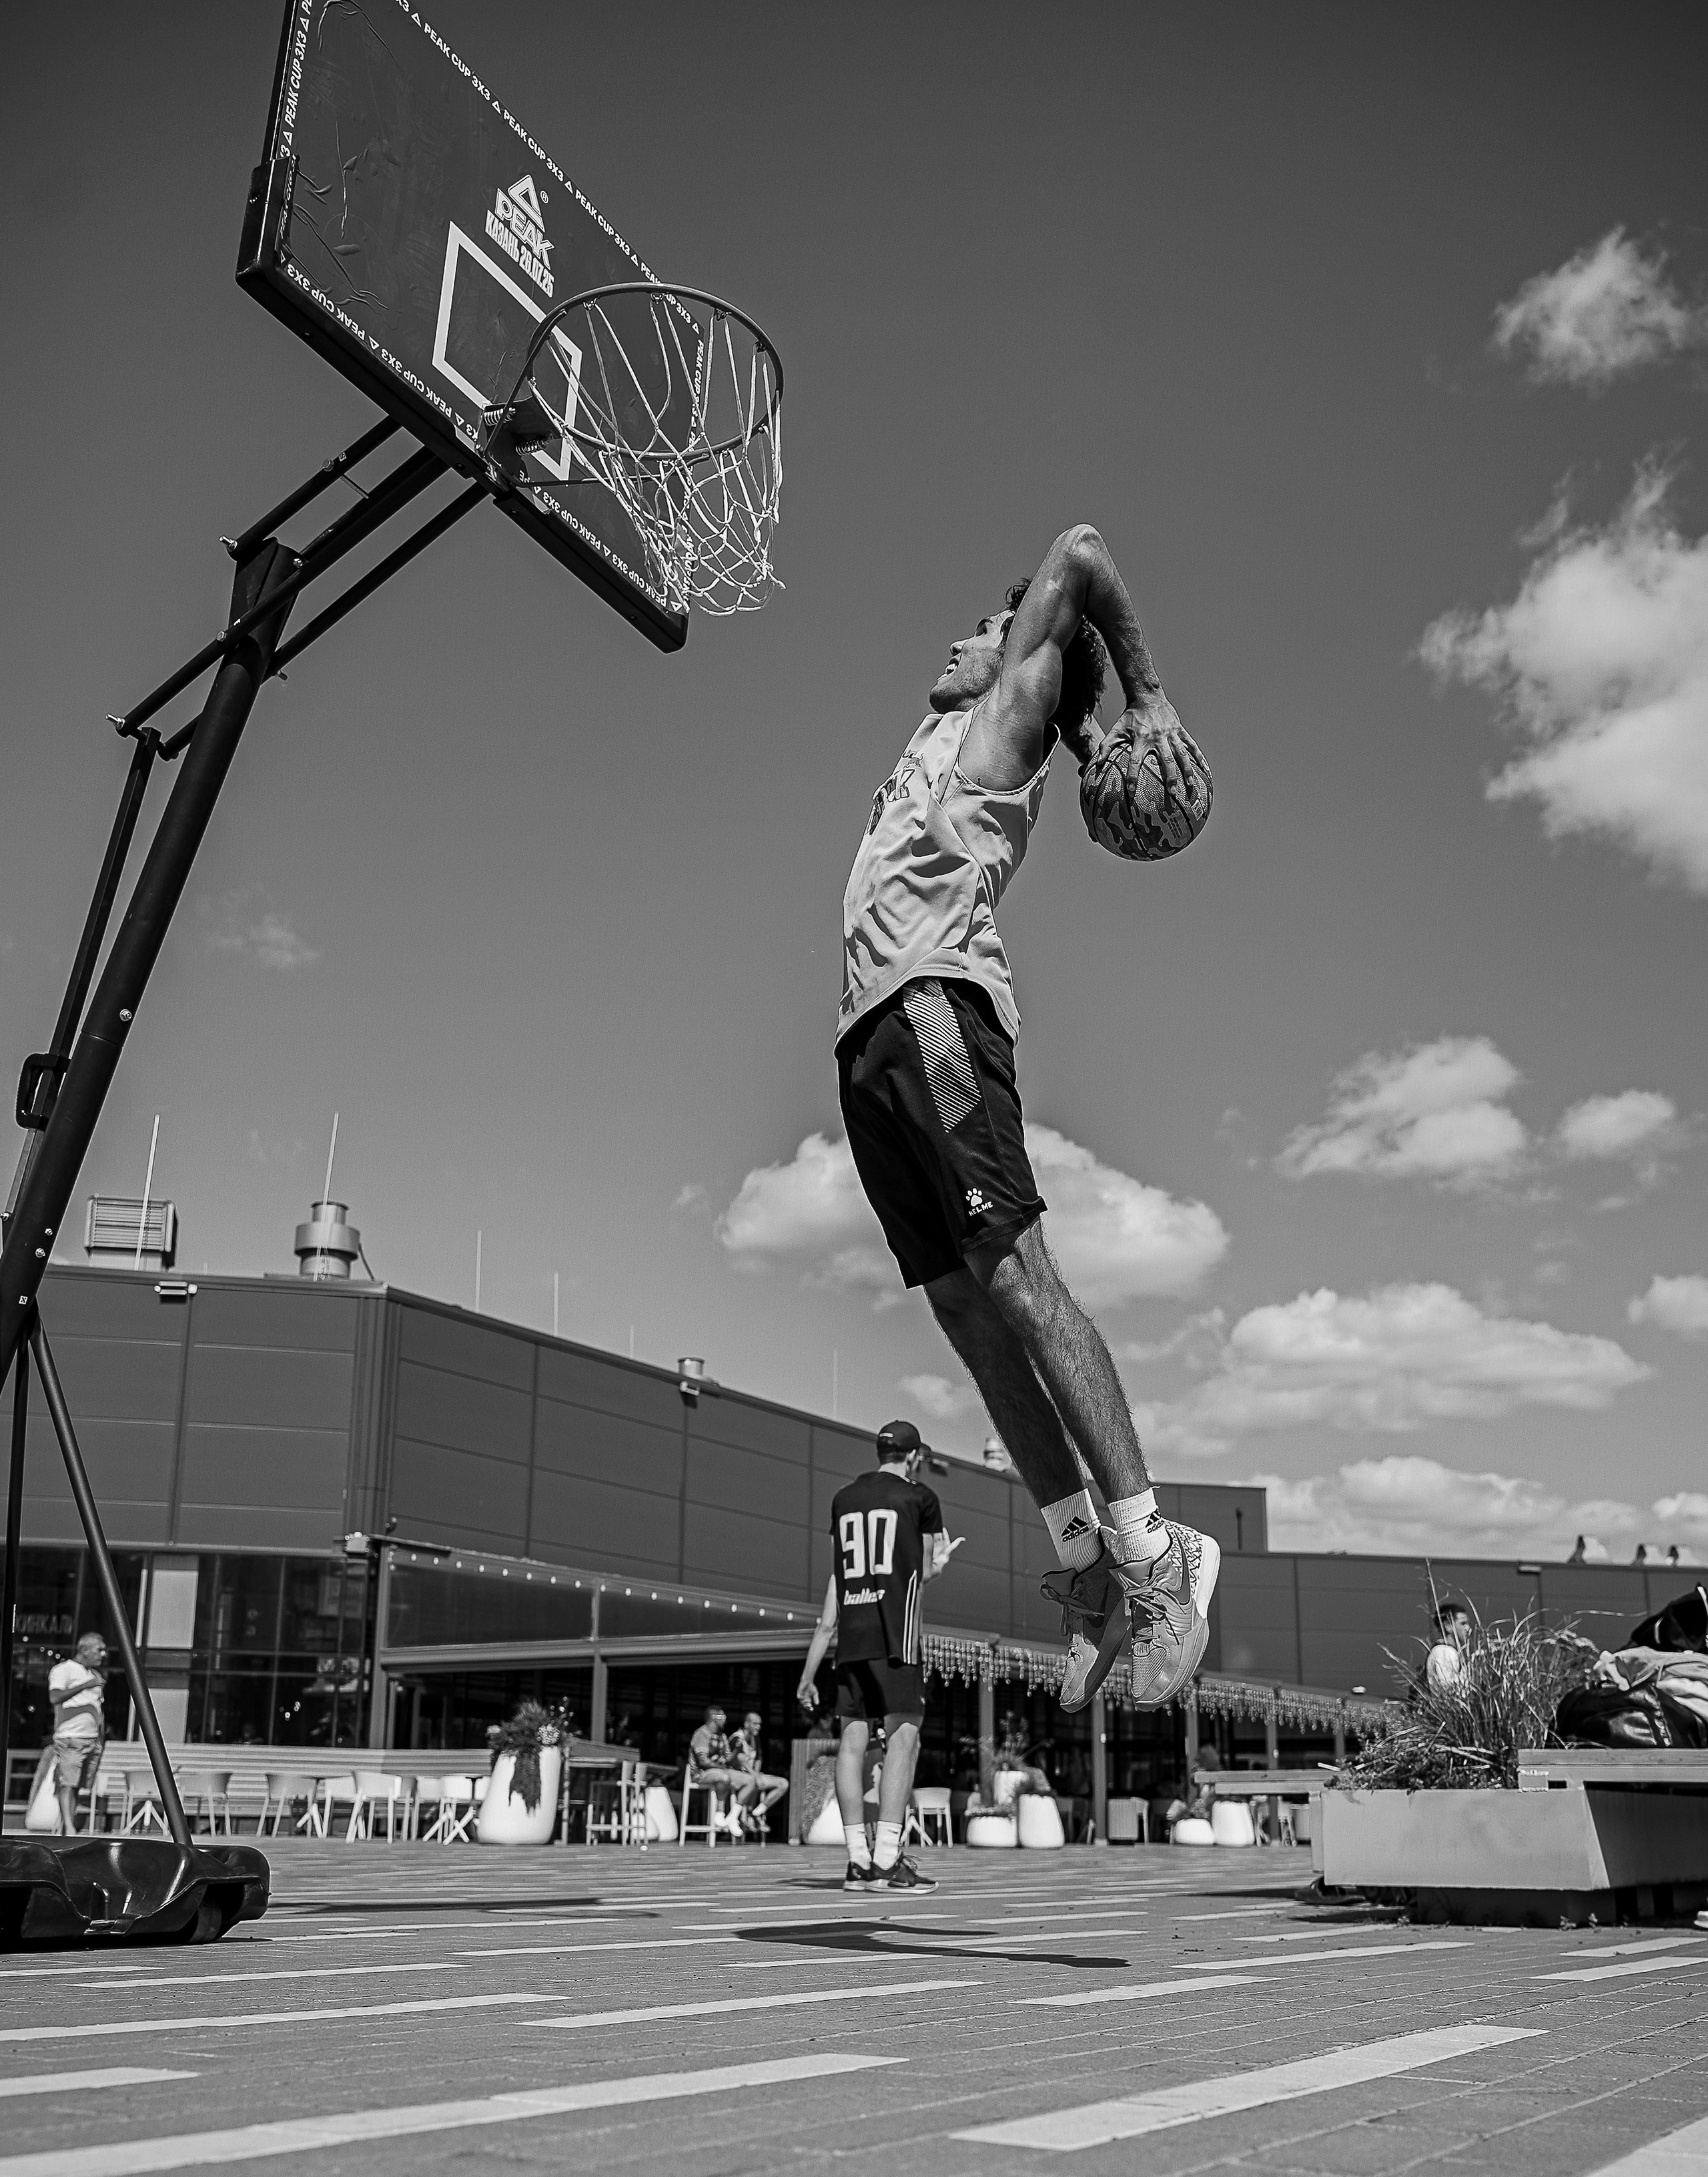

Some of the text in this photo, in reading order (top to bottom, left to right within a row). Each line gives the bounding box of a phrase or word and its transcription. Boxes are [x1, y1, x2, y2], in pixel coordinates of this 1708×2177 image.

[294, 30, 307, 61] 3X3
[424, 22, 490, 101] PEAK CUP 3X3
[290, 57, 302, 89] CUP
[284, 86, 299, 128] PEAK
[504, 109, 564, 182] PEAK CUP 3X3
[494, 188, 555, 270] PEAK
[575, 189, 630, 256] PEAK CUP 3X3
[484, 209, 555, 298] КАЗАНЬ 26.07.25
[287, 264, 366, 341] PEAK CUP 3X3
[676, 302, 691, 324] 3X3
[696, 339, 705, 371] PEAK
[381, 348, 452, 418] PEAK CUP 3X3
[694, 370, 702, 395] CUP
[542, 491, 600, 551] PEAK CUP 3X3
[612, 554, 628, 574] 3X3
[628, 570, 645, 589] CUP
[968, 1201, 993, 1217] KELME
[839, 1508, 898, 1580] 90
[1061, 1525, 1090, 1543] adidas
